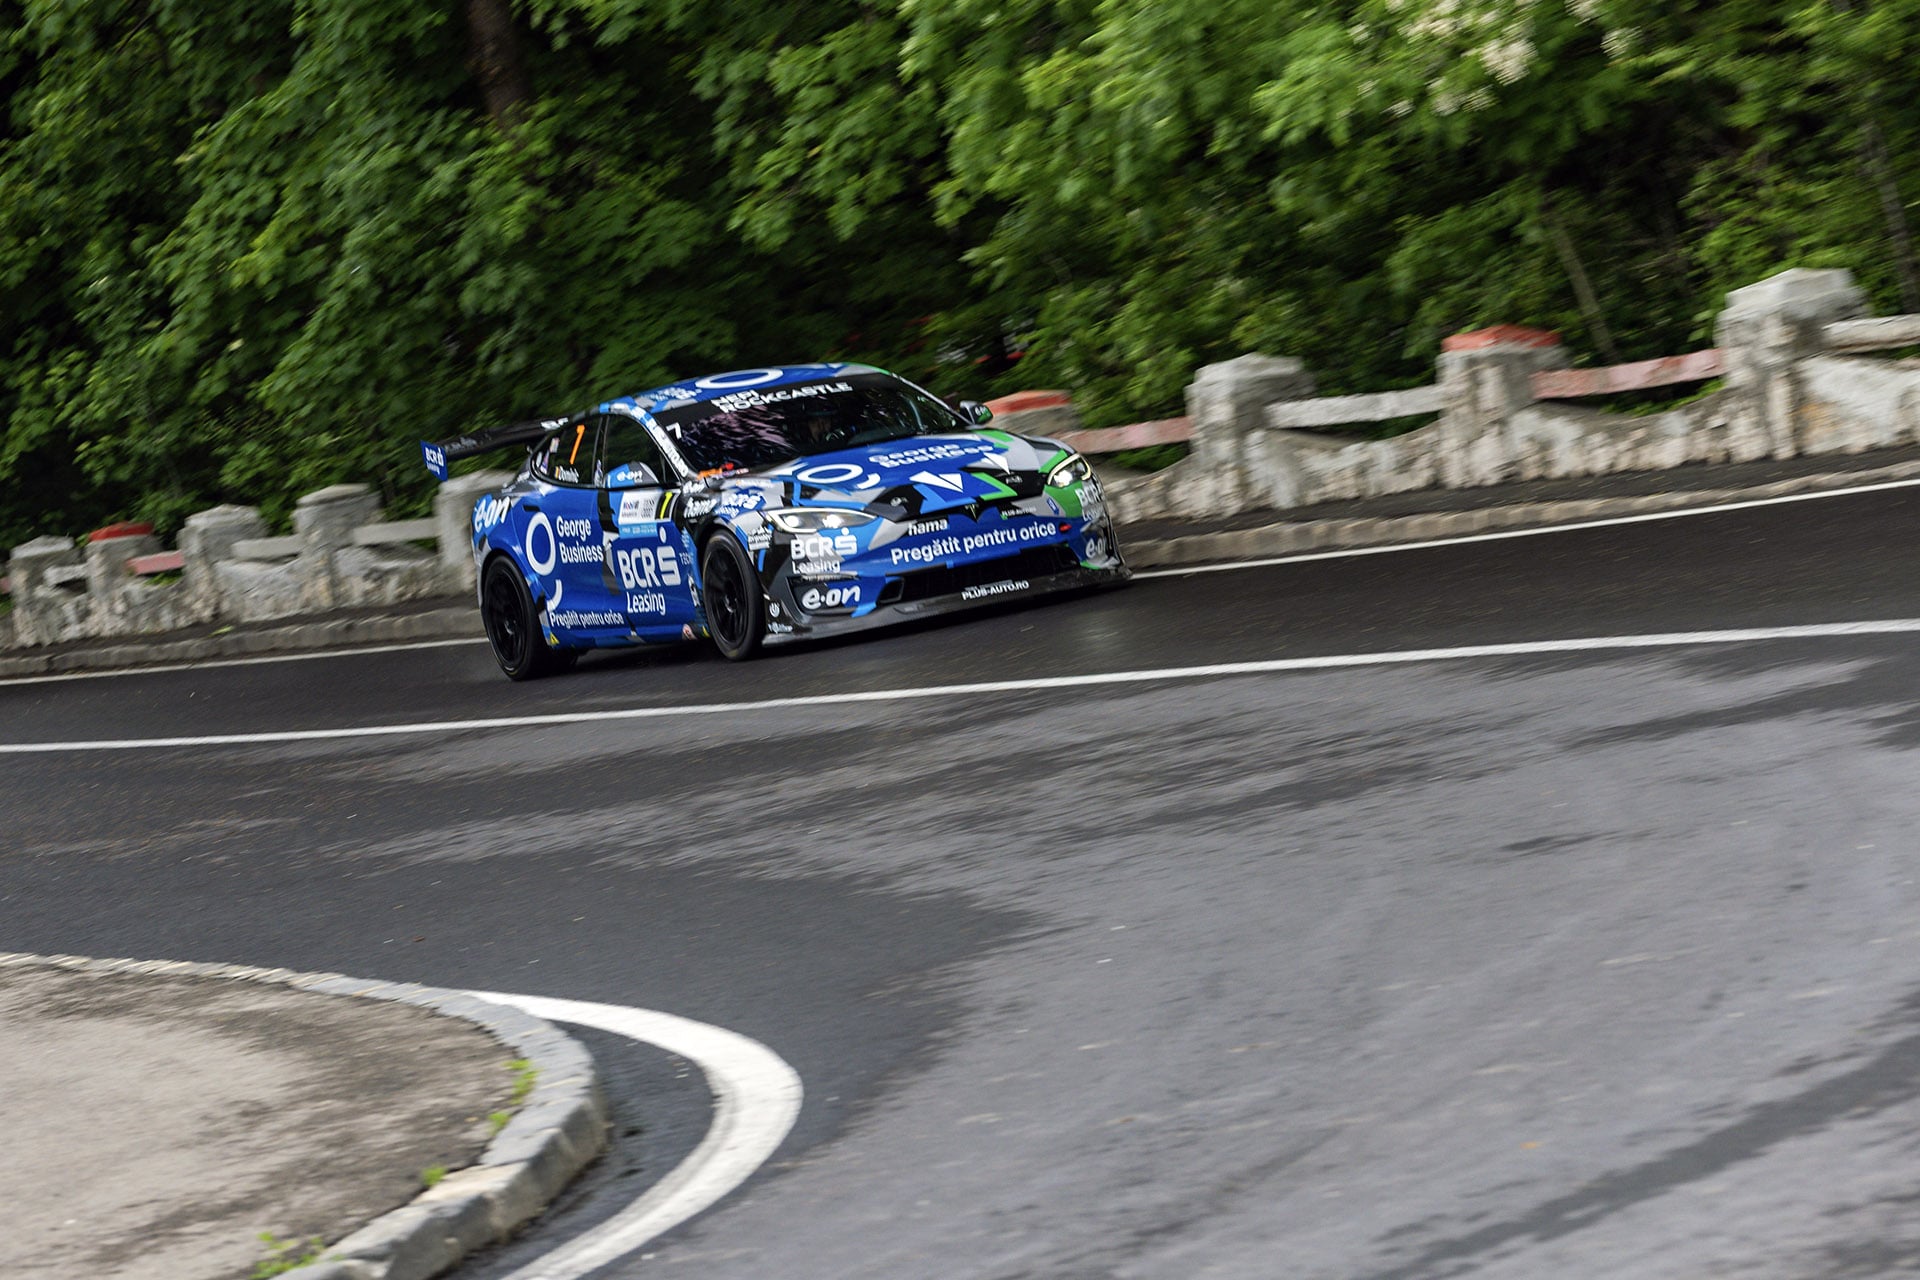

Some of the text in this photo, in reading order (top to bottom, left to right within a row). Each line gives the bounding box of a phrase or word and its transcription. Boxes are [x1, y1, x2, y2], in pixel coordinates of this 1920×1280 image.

[719, 382, 853, 413] ROCKCASTLE
[868, 444, 960, 462] George
[879, 445, 994, 468] Business
[556, 515, 592, 542] George
[908, 518, 948, 536] hama
[558, 541, 604, 564] Business
[890, 521, 1057, 565] Pregătit pentru orice
[792, 558, 841, 574] Leasing
[626, 590, 666, 616] Leasing
[580, 611, 605, 628] pentru
[604, 609, 625, 625] orice
